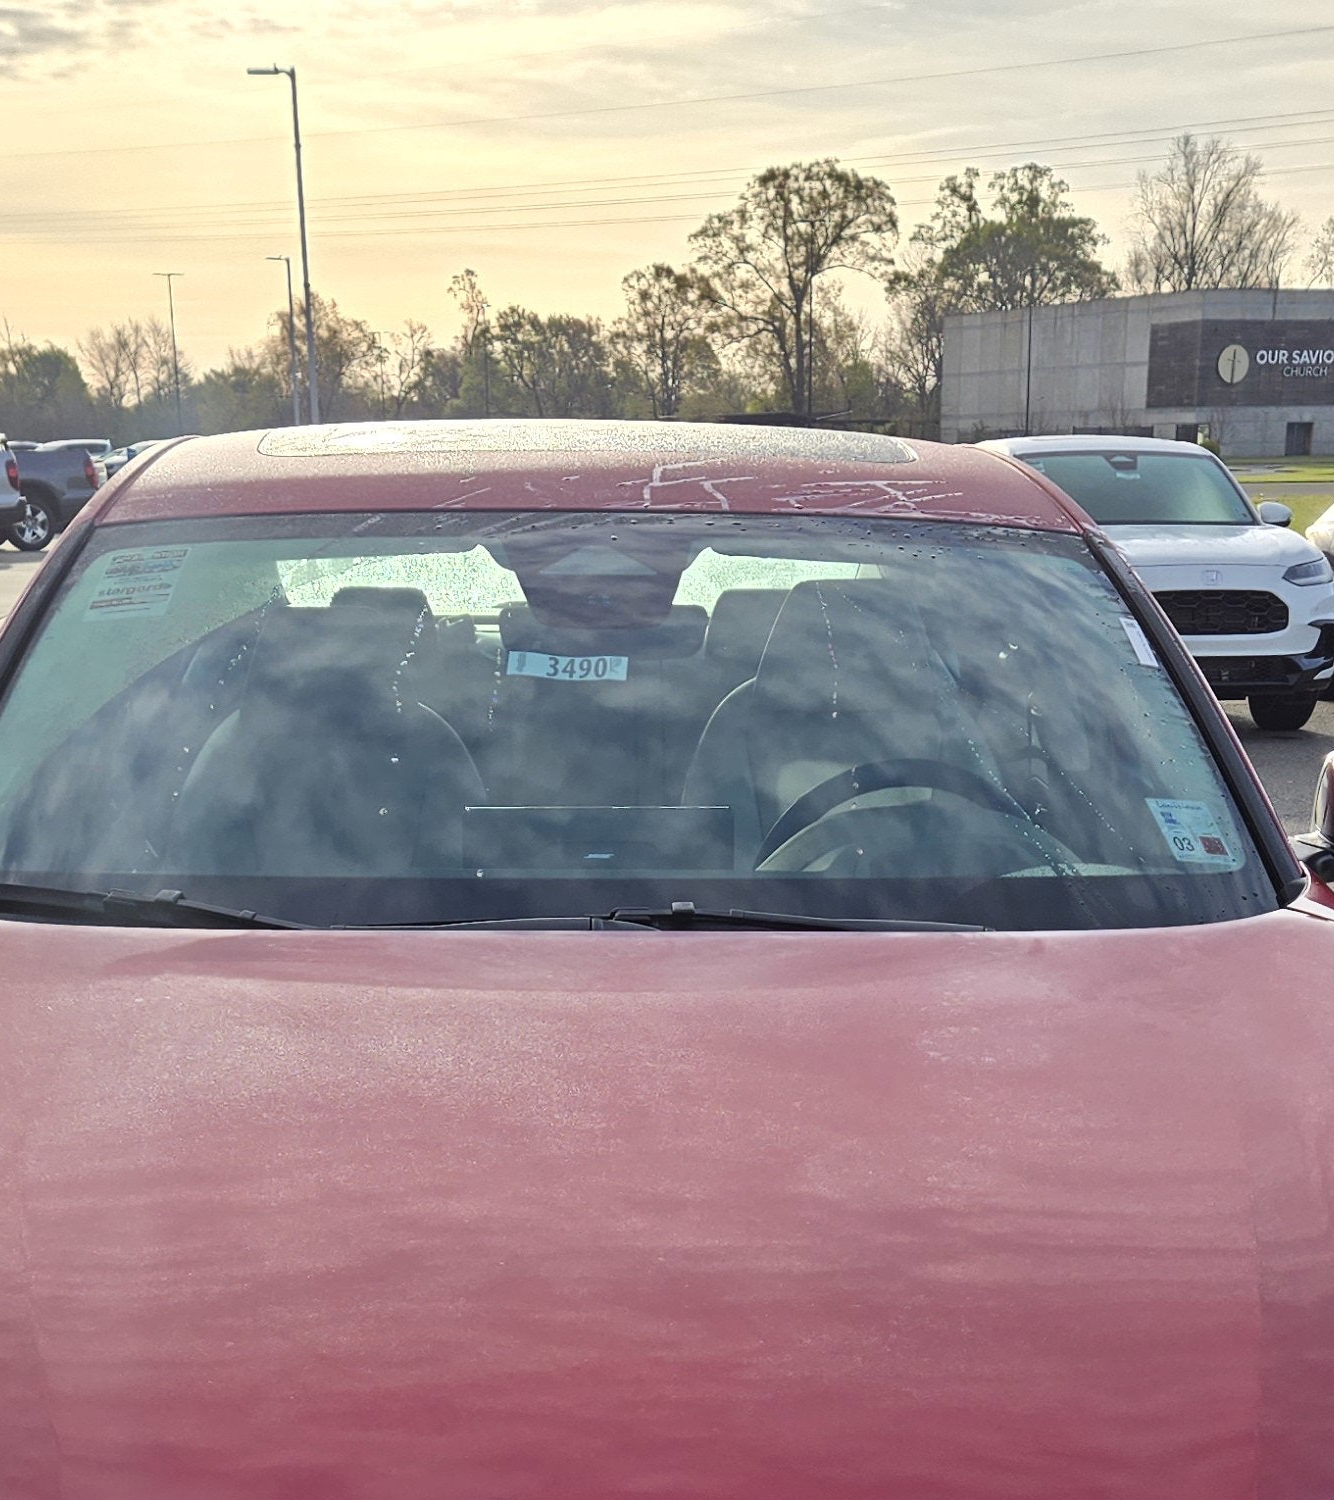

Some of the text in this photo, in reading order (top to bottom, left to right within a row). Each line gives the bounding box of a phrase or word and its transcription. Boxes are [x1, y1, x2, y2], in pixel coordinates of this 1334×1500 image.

[1256, 349, 1289, 365] OUR
[1282, 366, 1328, 377] CHURCH
[546, 657, 608, 679] 3490
[1173, 836, 1195, 852] 03
